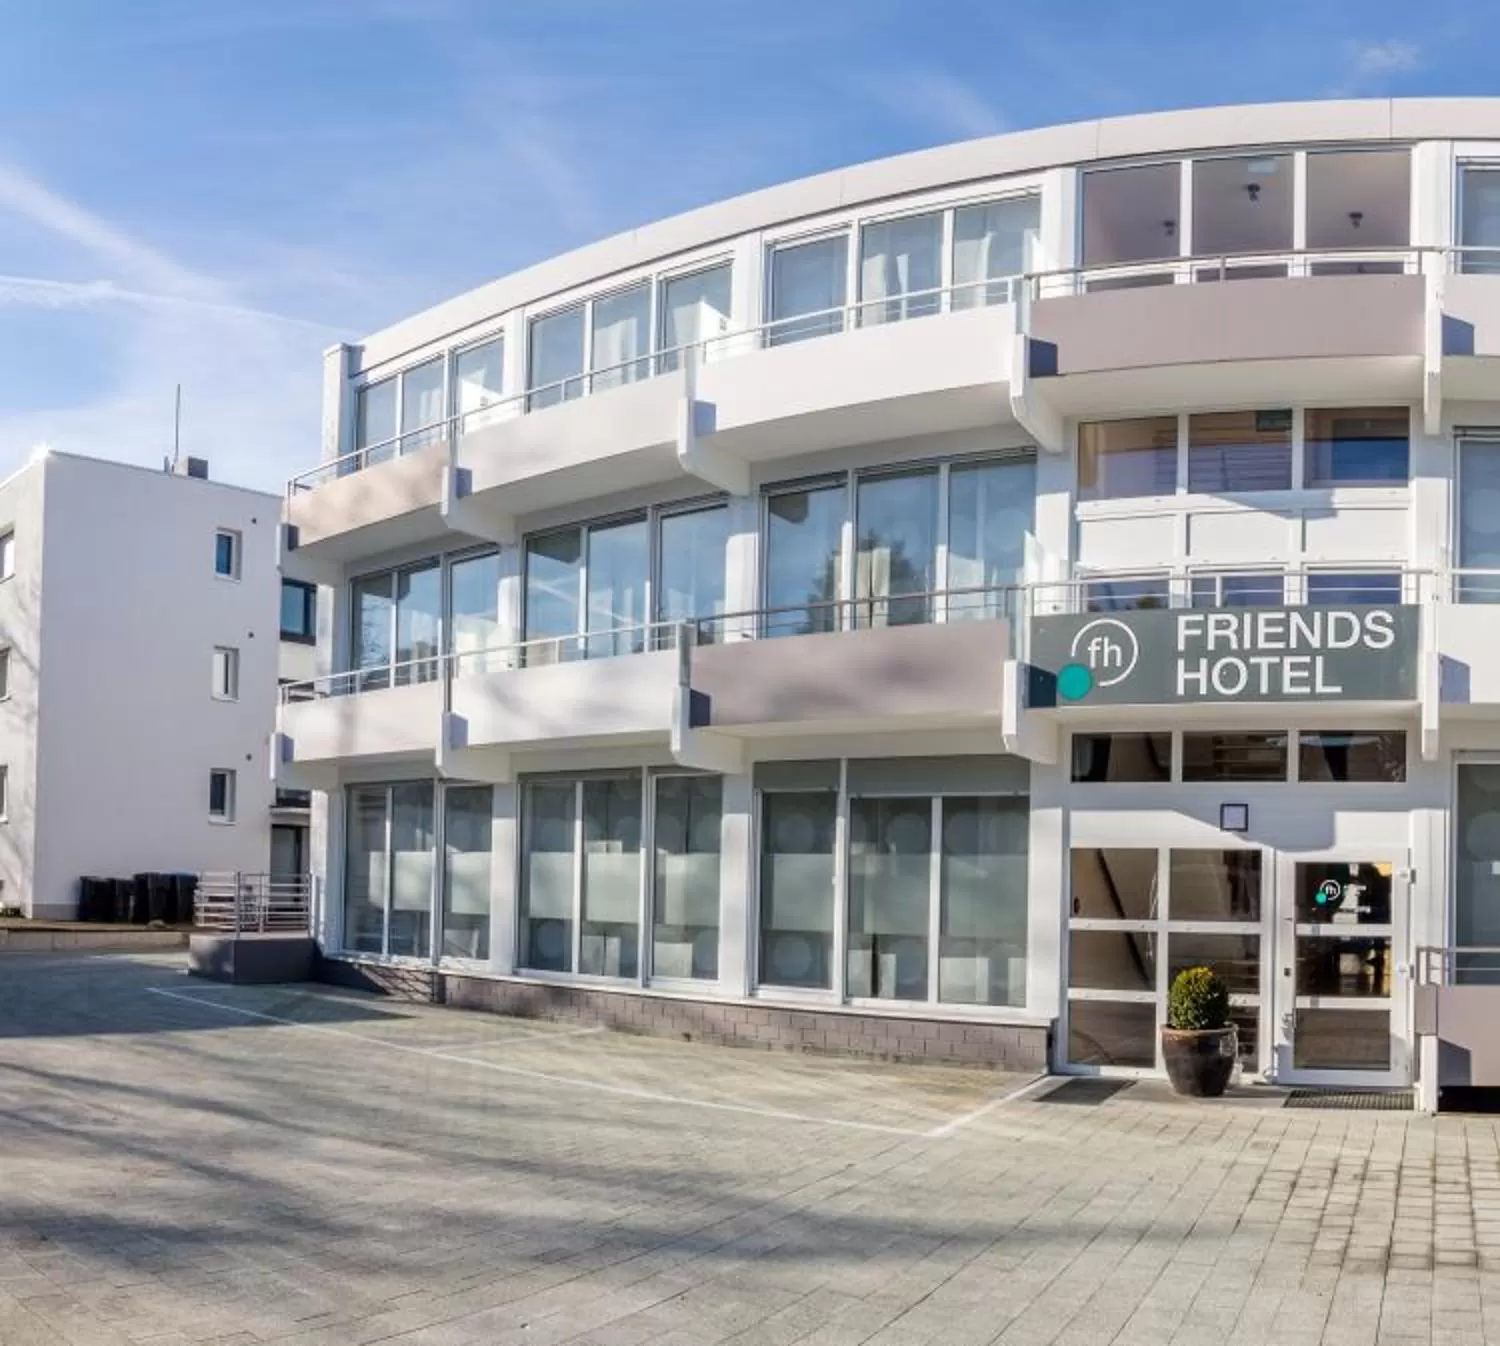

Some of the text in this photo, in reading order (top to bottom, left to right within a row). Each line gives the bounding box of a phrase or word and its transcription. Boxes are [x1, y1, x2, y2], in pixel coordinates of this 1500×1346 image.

[1176, 610, 1395, 651] FRIENDS
[1087, 636, 1122, 668] fh
[1176, 655, 1343, 695] HOTEL
